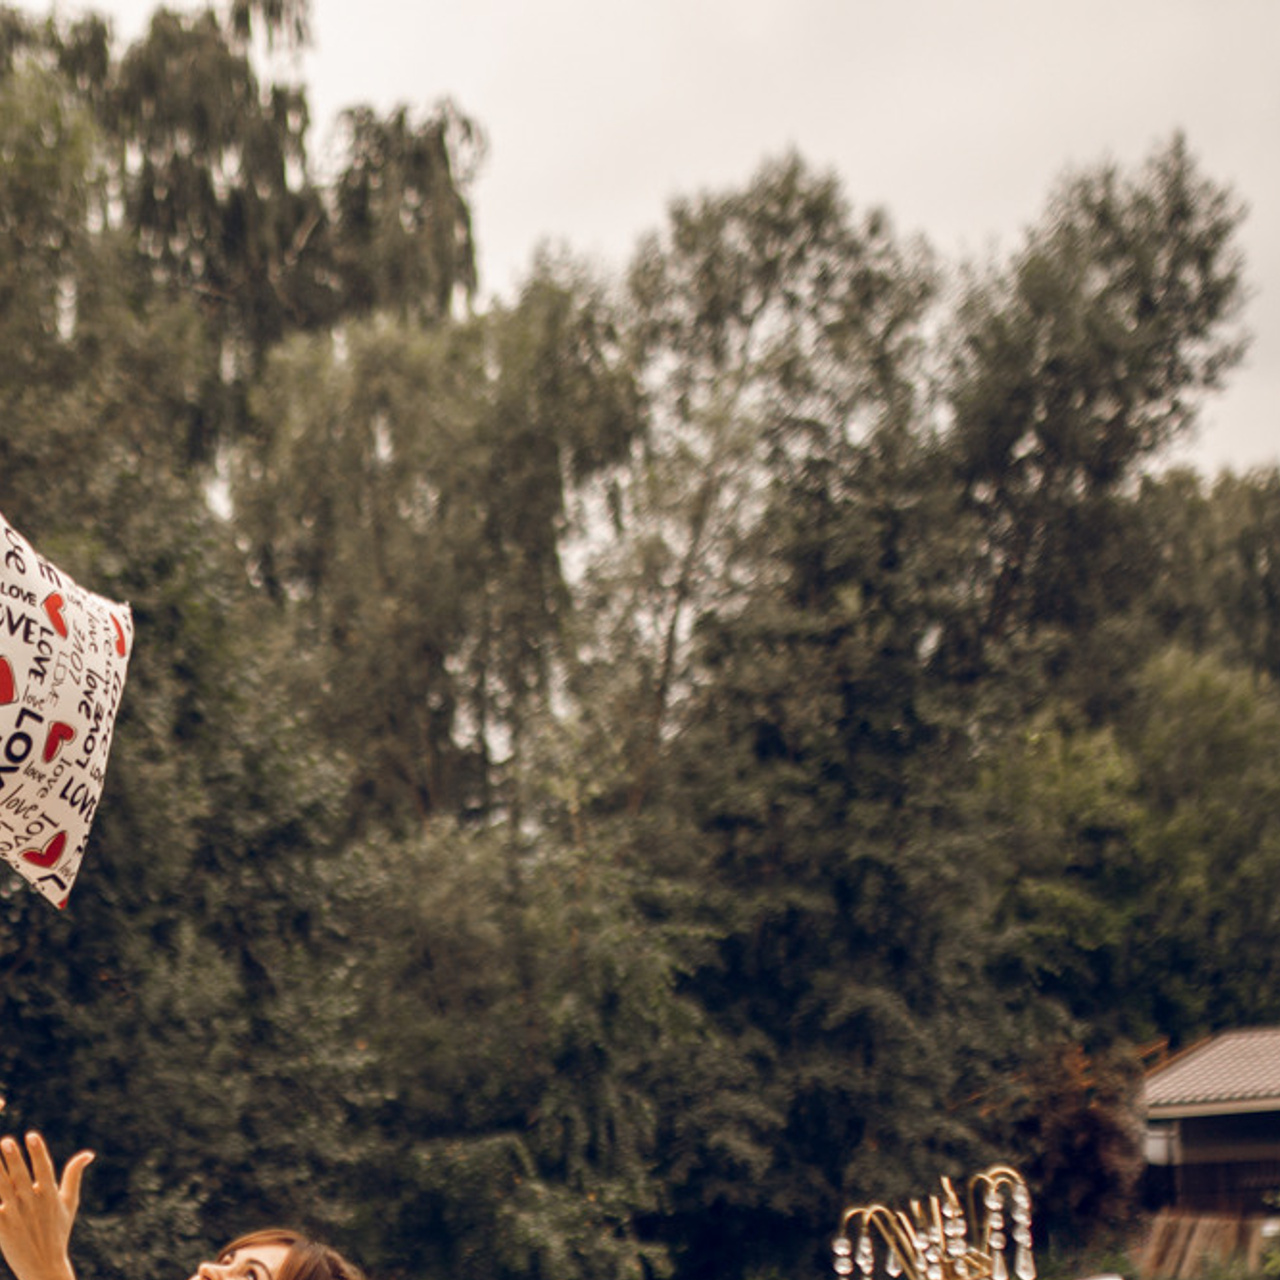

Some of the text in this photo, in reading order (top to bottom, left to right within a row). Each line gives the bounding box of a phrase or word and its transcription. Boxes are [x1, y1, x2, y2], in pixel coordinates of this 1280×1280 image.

[0, 581, 37, 608] LOVE
[28, 626, 54, 686] LOVE
[77, 668, 110, 719] love
[74, 702, 105, 770] LOVE
[34, 755, 73, 799] love
[0, 783, 39, 820] love
